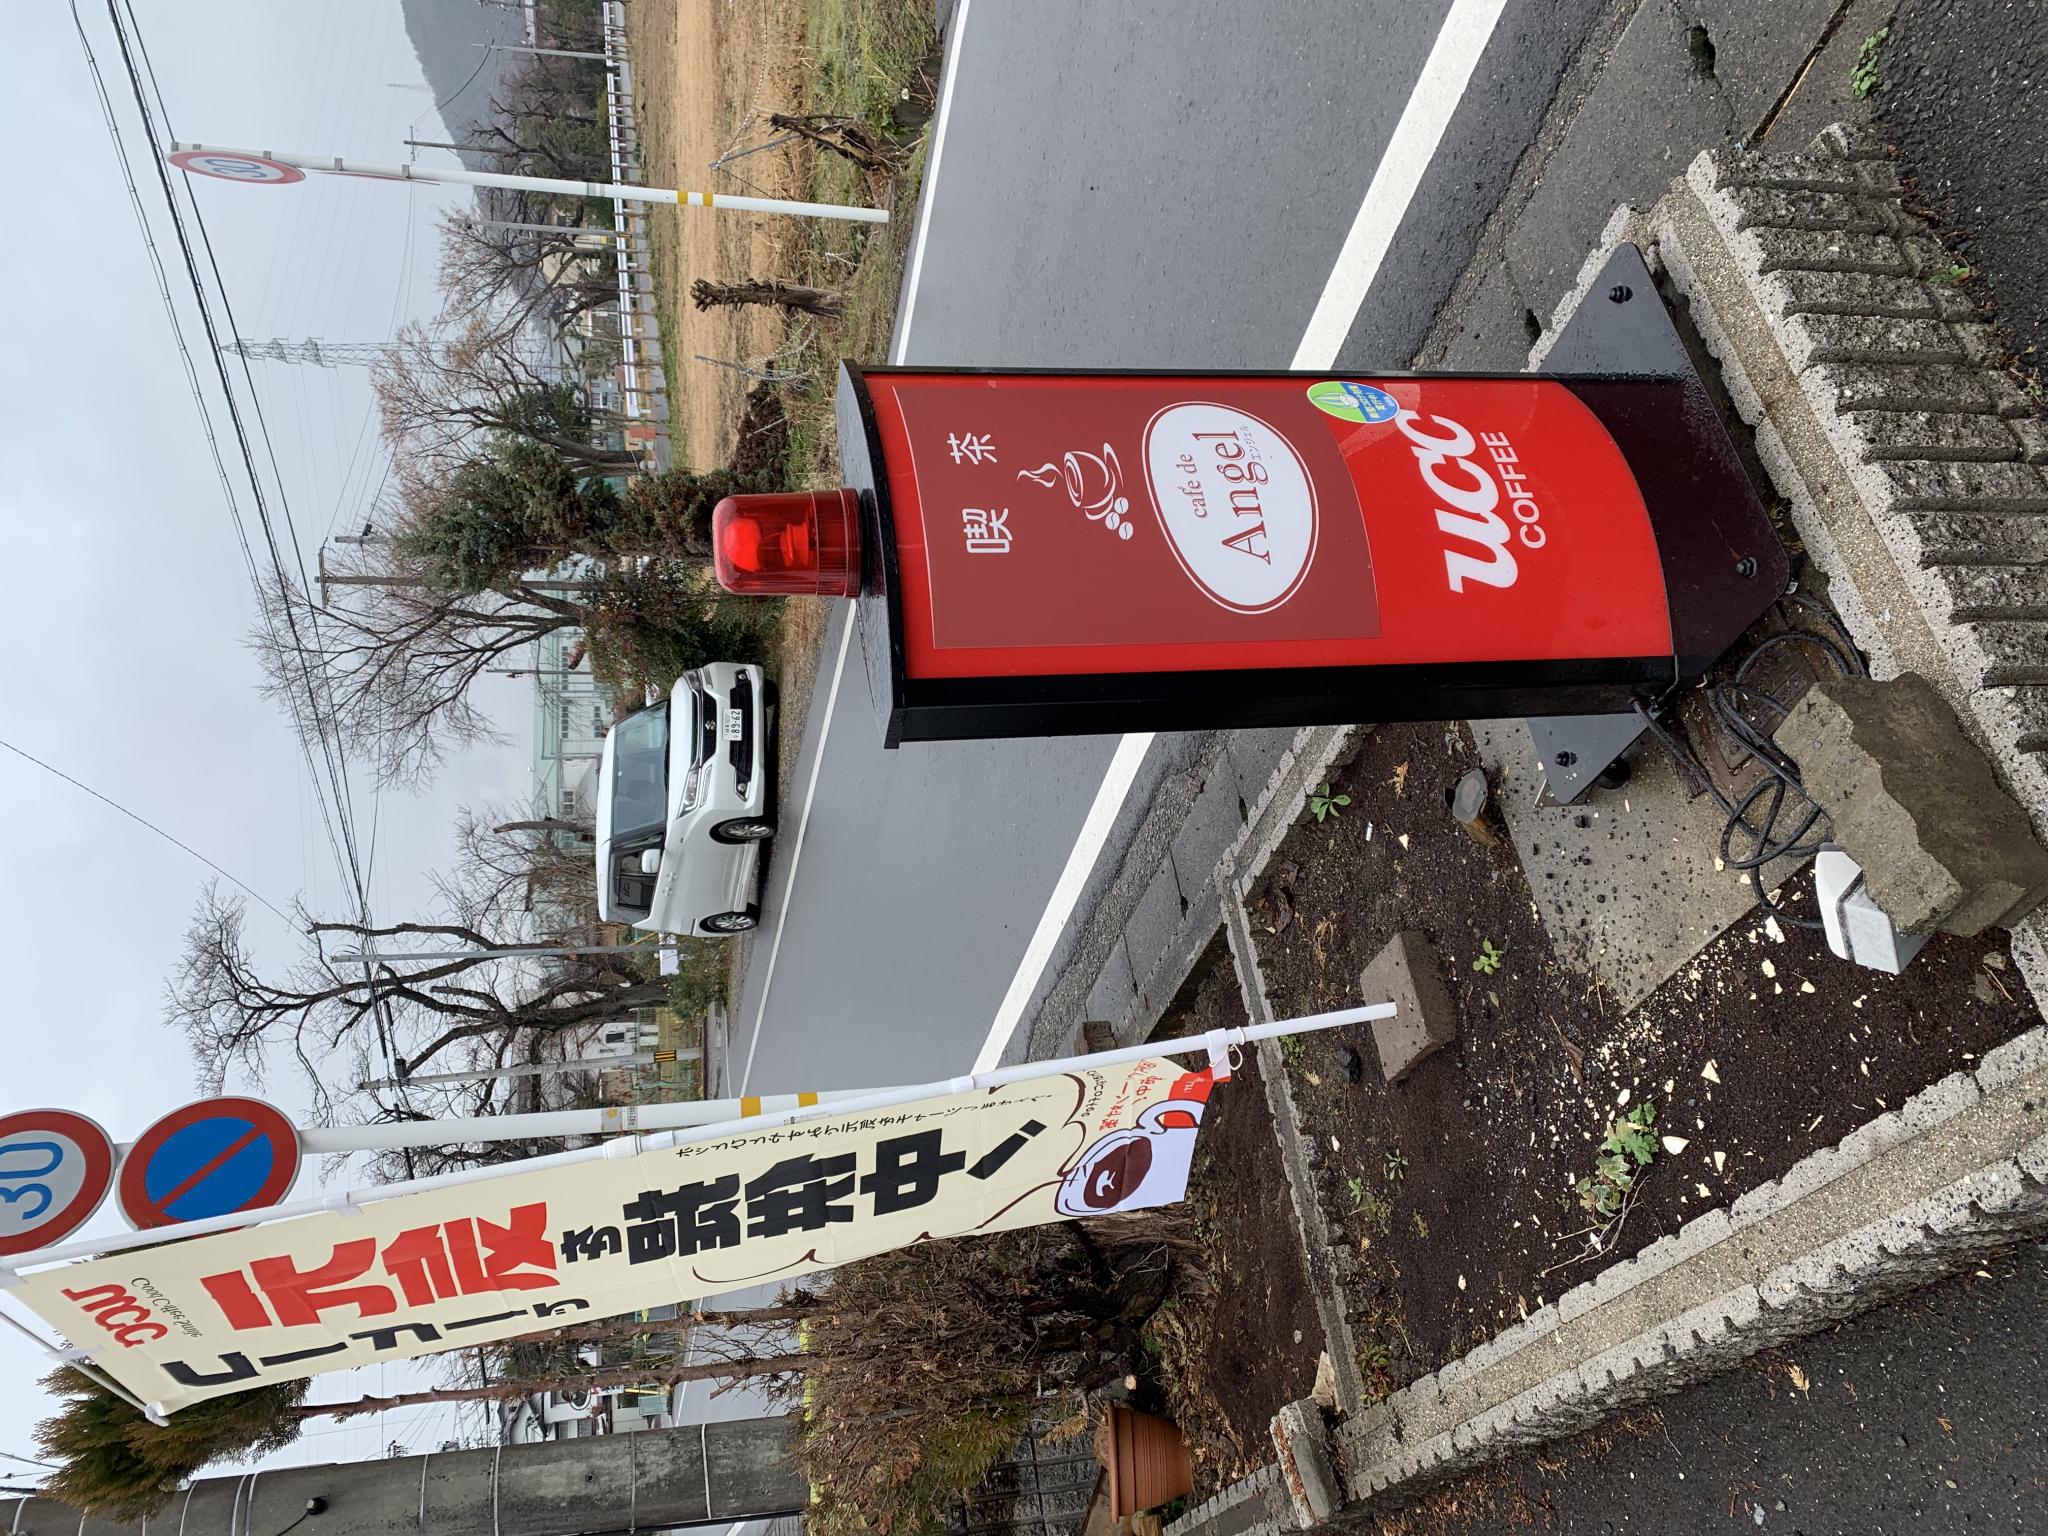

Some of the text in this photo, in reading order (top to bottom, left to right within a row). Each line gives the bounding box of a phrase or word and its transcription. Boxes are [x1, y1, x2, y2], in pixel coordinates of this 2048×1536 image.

[205, 159, 267, 177] 30
[947, 431, 1013, 553] 喫茶
[1176, 453, 1198, 474] de
[1193, 428, 1270, 564] Angel
[1394, 405, 1518, 593] UCC
[1480, 431, 1547, 548] COFFEE
[730, 710, 740, 733] 89-62
[0, 1142, 63, 1219] 30
